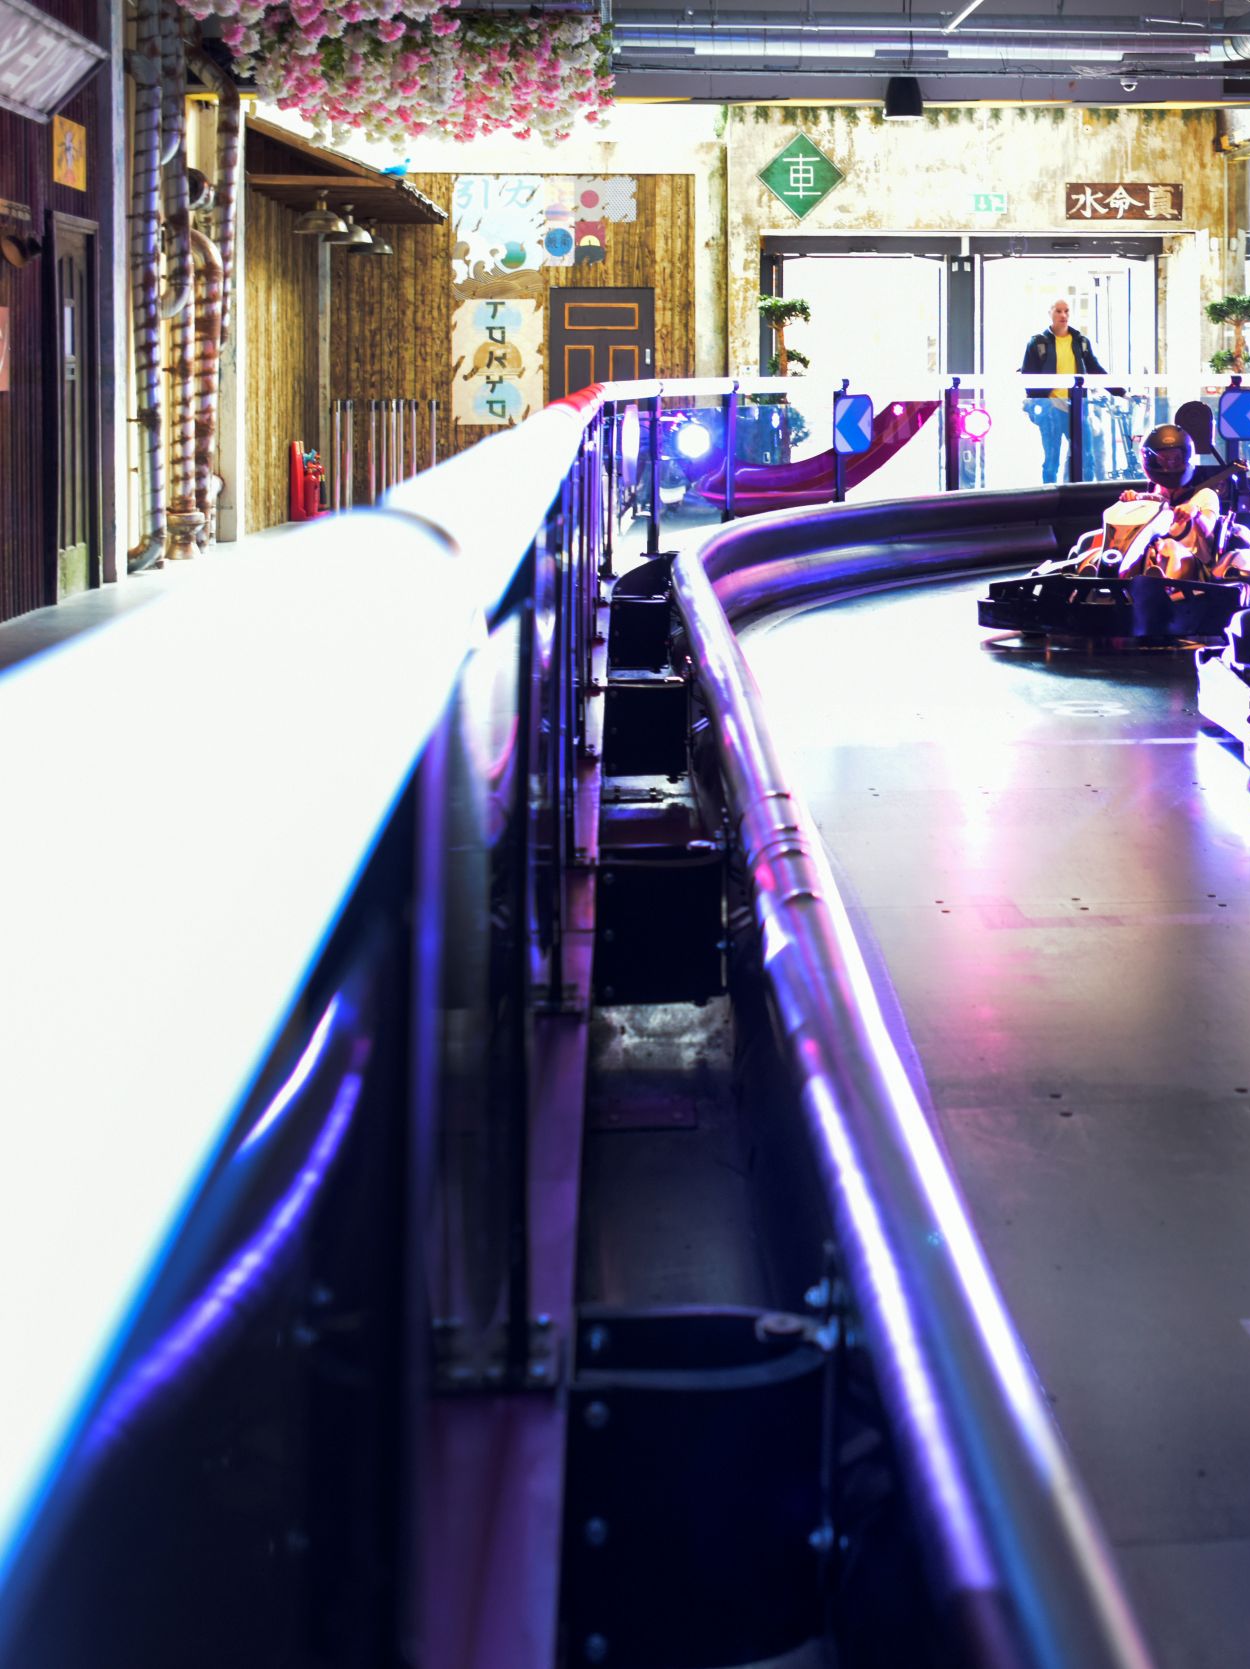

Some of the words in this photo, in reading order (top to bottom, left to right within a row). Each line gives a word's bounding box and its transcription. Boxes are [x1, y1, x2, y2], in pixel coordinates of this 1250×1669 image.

[456, 178, 536, 209] 引力
[782, 152, 822, 199] 車
[485, 301, 506, 419] TOKYO
